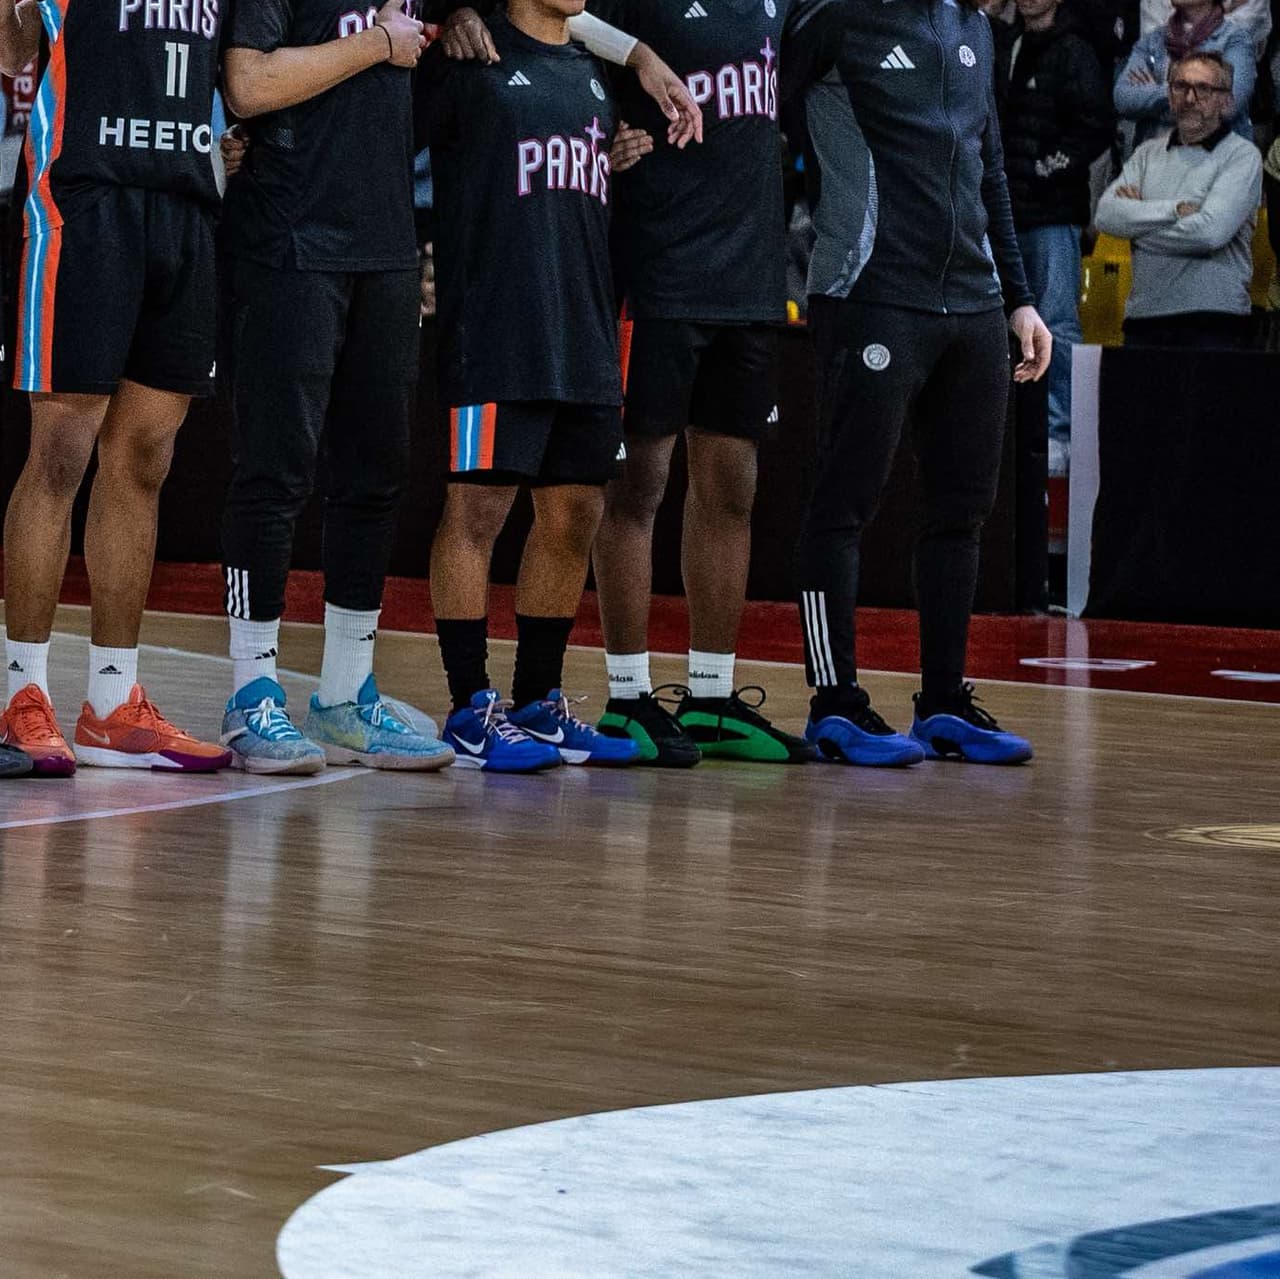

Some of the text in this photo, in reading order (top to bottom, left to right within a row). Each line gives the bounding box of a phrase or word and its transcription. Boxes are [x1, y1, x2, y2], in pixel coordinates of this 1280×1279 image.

[165, 40, 190, 98] 11
[686, 36, 777, 121] PARIS
[99, 116, 213, 154] HEETC
[518, 116, 611, 206] PARIS
